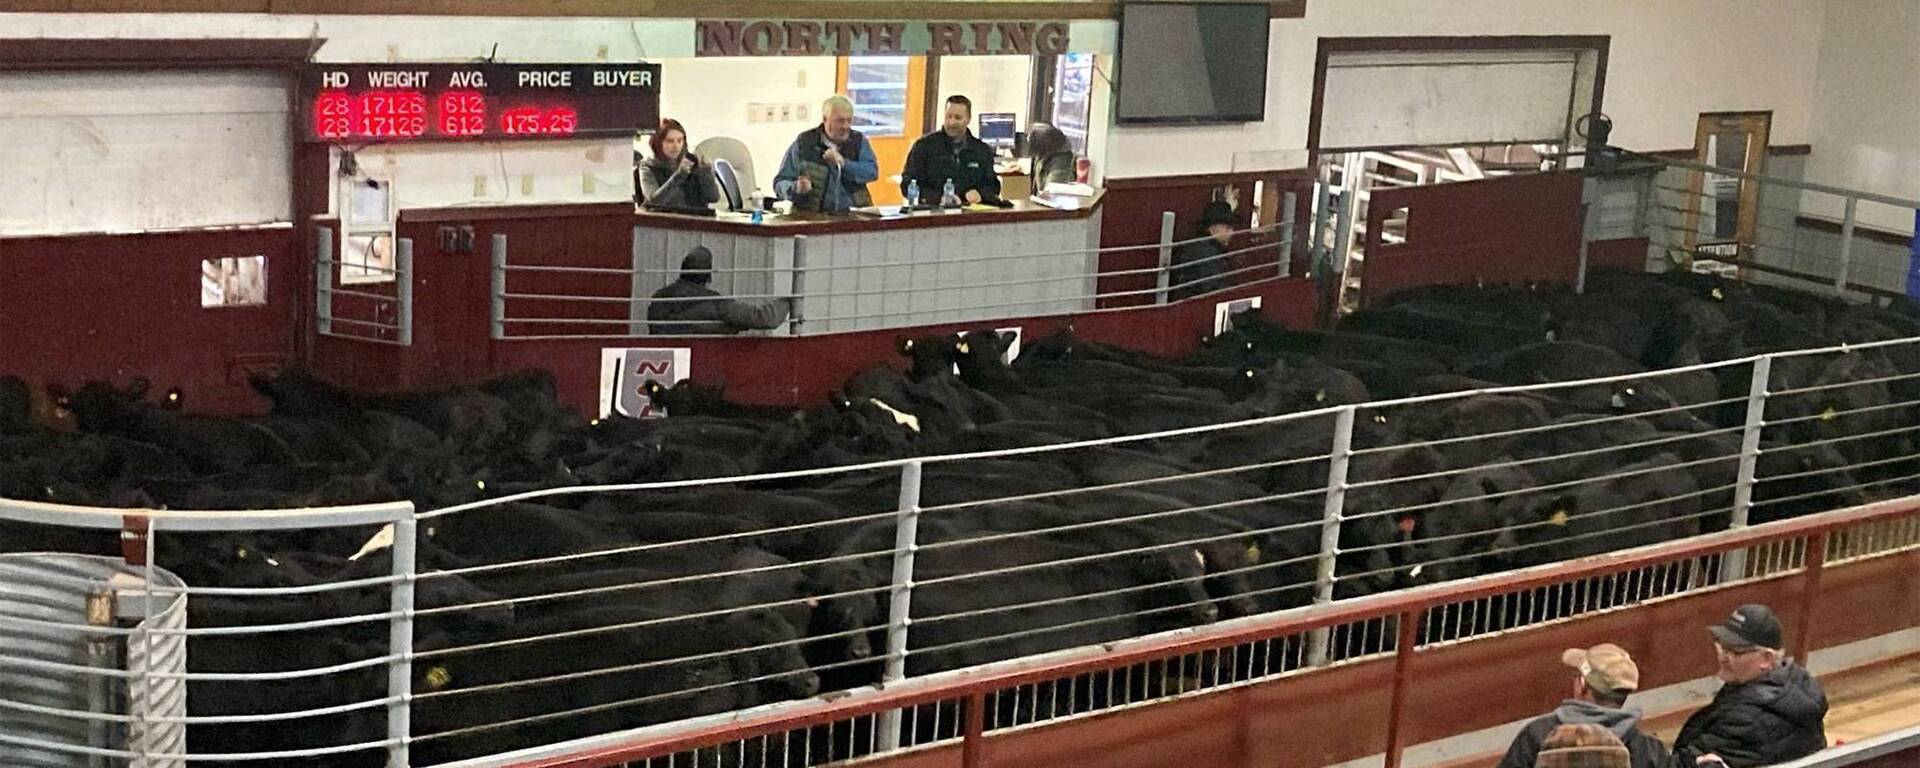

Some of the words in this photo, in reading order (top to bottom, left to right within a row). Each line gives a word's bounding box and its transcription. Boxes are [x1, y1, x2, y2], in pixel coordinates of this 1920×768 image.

[696, 20, 906, 56] NORTH
[929, 22, 1070, 56] RING
[322, 71, 349, 88] HD
[368, 71, 430, 88] WEIGHT
[449, 71, 487, 87] AVG.
[518, 71, 571, 87] PRICE
[593, 71, 652, 87] BUYER
[322, 98, 349, 115] 28
[362, 97, 425, 115] 17126
[445, 96, 483, 114] 612
[323, 117, 350, 138] 28
[363, 117, 425, 137] 17126
[446, 117, 484, 136] 612
[506, 115, 576, 135] 175.25
